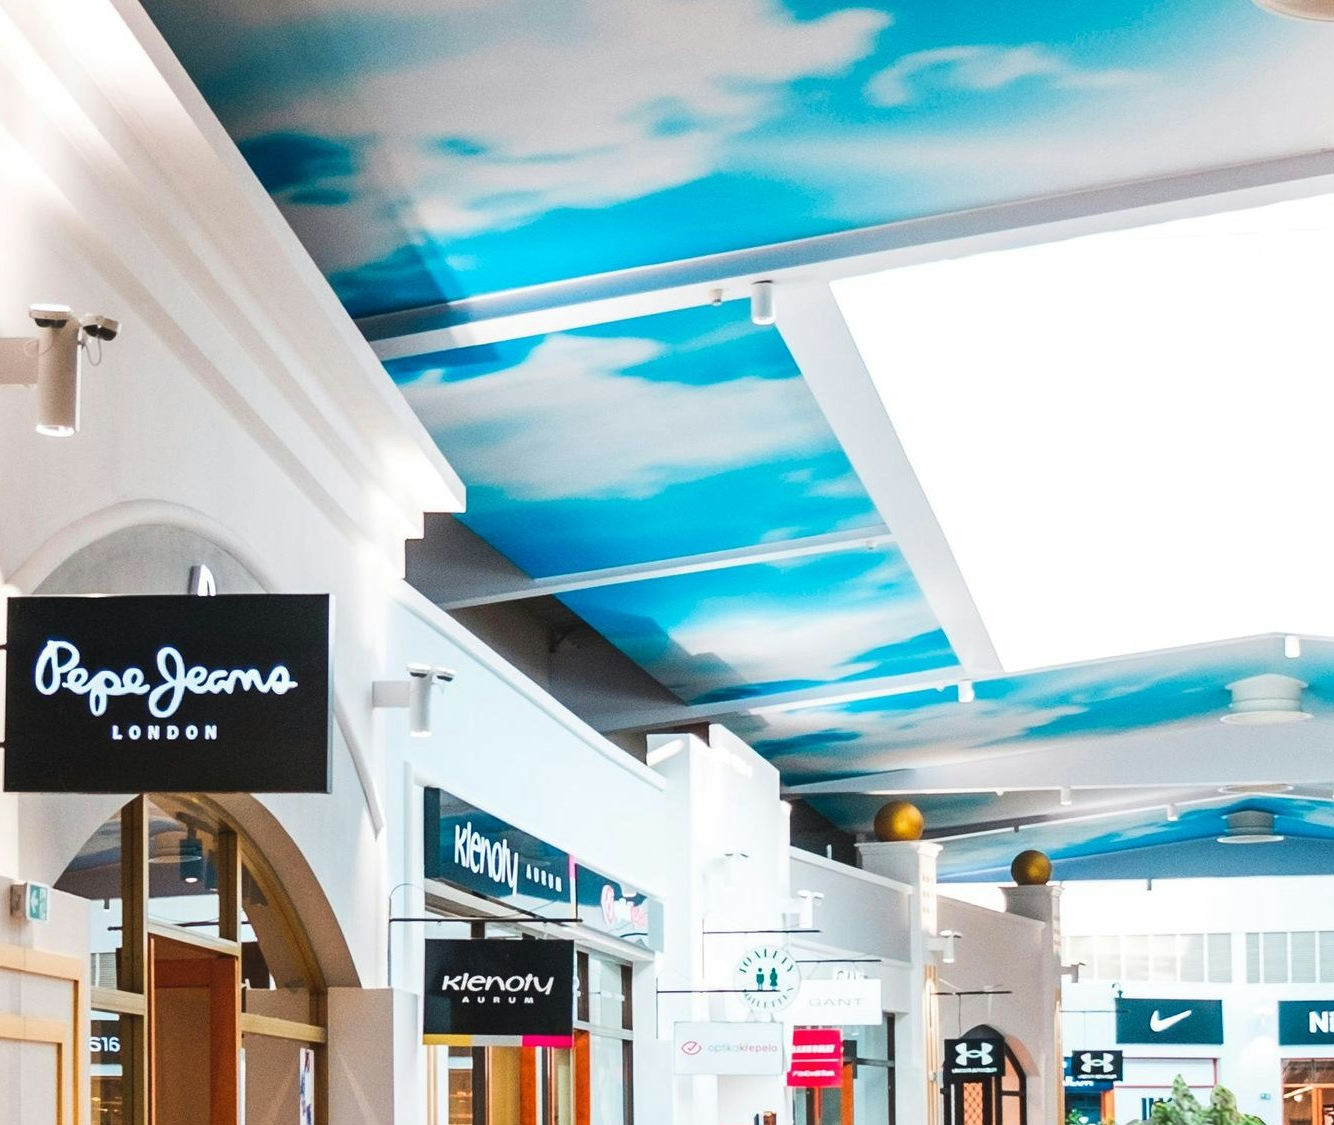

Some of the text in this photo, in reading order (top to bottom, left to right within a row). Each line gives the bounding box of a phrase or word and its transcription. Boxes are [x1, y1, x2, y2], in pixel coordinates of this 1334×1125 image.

[35, 640, 298, 718] Pepe Jeans
[111, 724, 219, 741] LONDON
[526, 863, 562, 893] AURUM
[462, 996, 534, 1004] AURUM
[809, 998, 864, 1007] GANT
